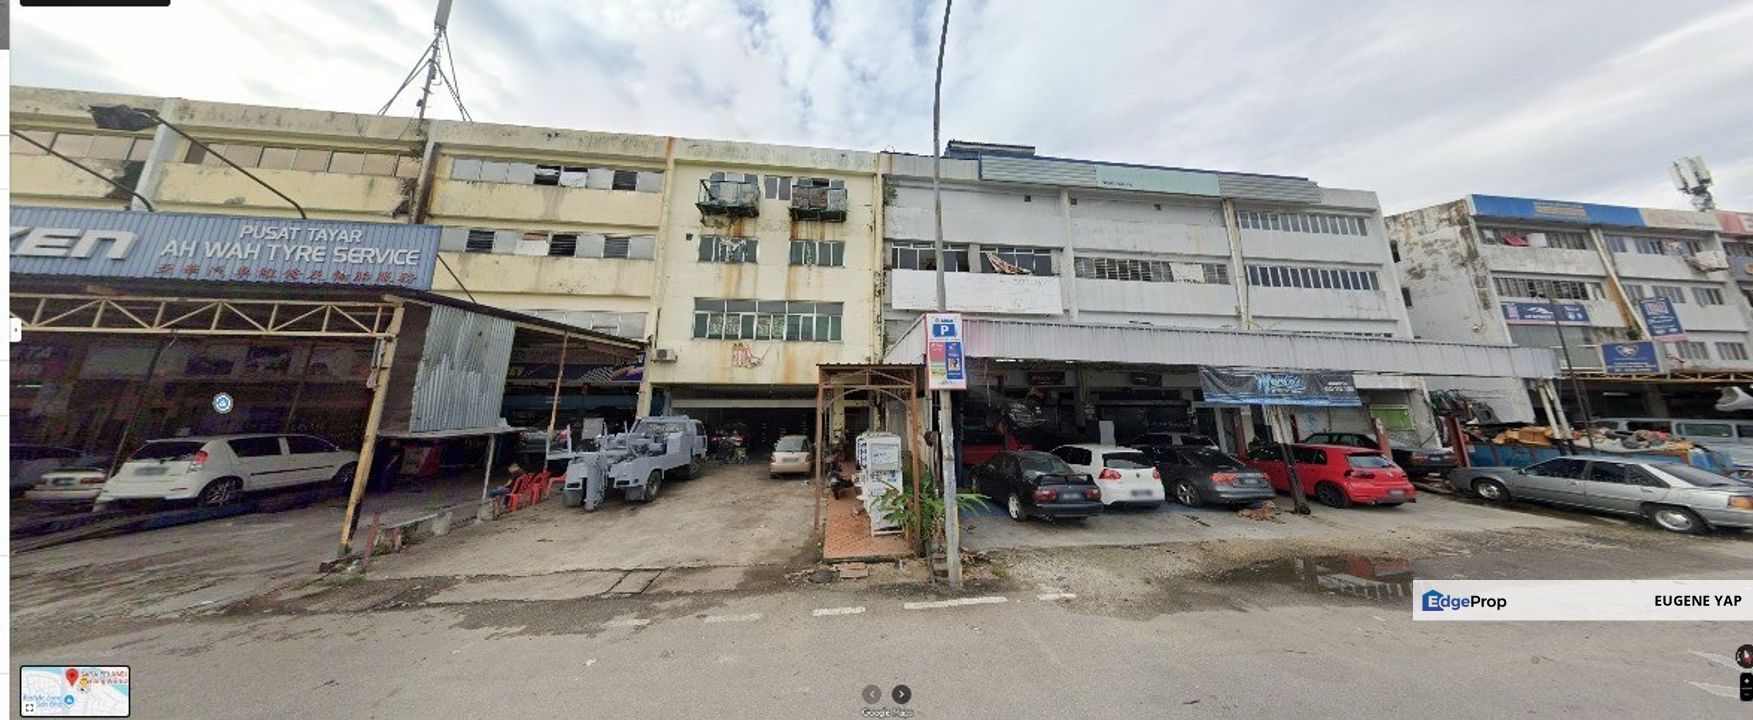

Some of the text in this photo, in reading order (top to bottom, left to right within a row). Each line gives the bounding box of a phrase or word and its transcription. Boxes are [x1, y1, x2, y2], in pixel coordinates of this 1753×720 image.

[10, 226, 138, 260] EN
[240, 225, 362, 243] PUSAT TAYAR
[160, 240, 420, 266] AH WAH TYRE SERVICE
[941, 325, 949, 335] P
